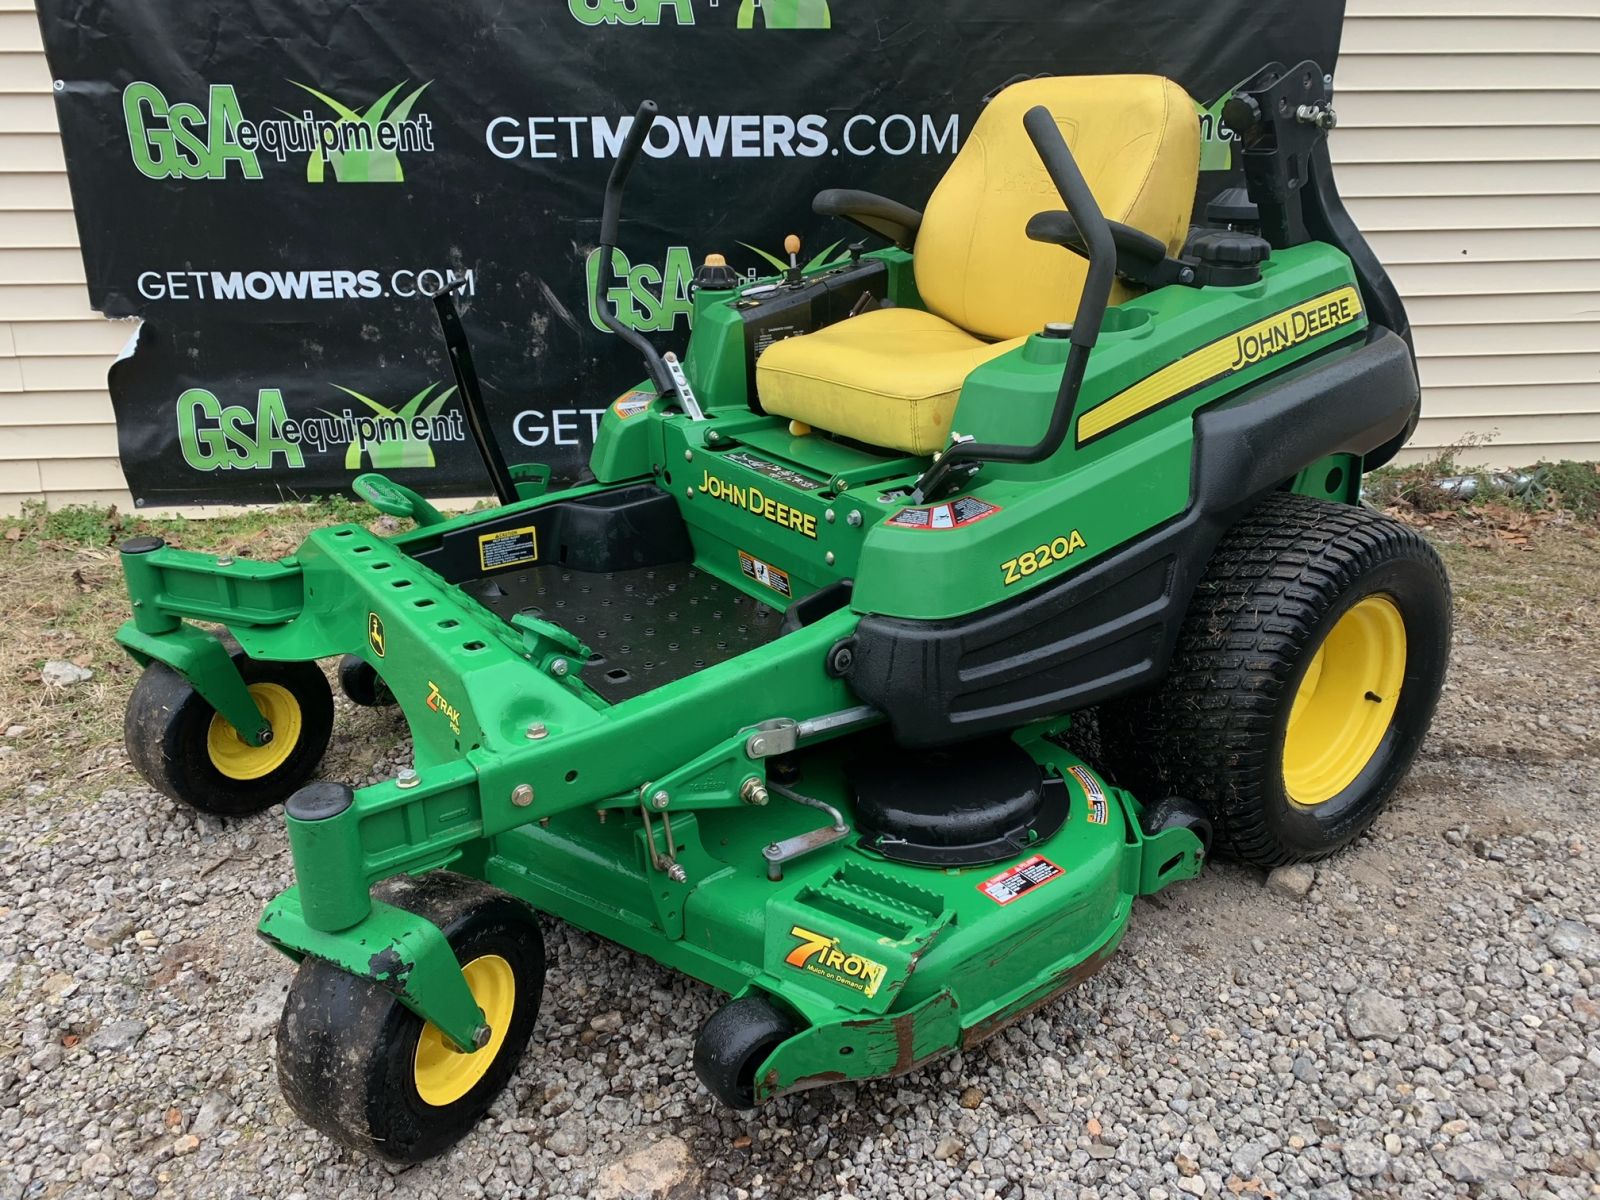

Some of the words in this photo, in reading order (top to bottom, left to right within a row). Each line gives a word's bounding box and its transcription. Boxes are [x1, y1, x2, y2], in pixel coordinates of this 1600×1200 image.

[485, 113, 960, 160] GETMOWERS.COM
[136, 268, 476, 301] GETMOWERS.COM
[1231, 320, 1290, 369] JOHN
[1291, 296, 1353, 341] DEERE
[698, 469, 748, 510] JOHN
[749, 486, 818, 541] DEERE
[1000, 528, 1087, 586] Z820A
[806, 964, 826, 977] Mulch
[826, 972, 835, 980] on
[835, 974, 864, 991] Demand
